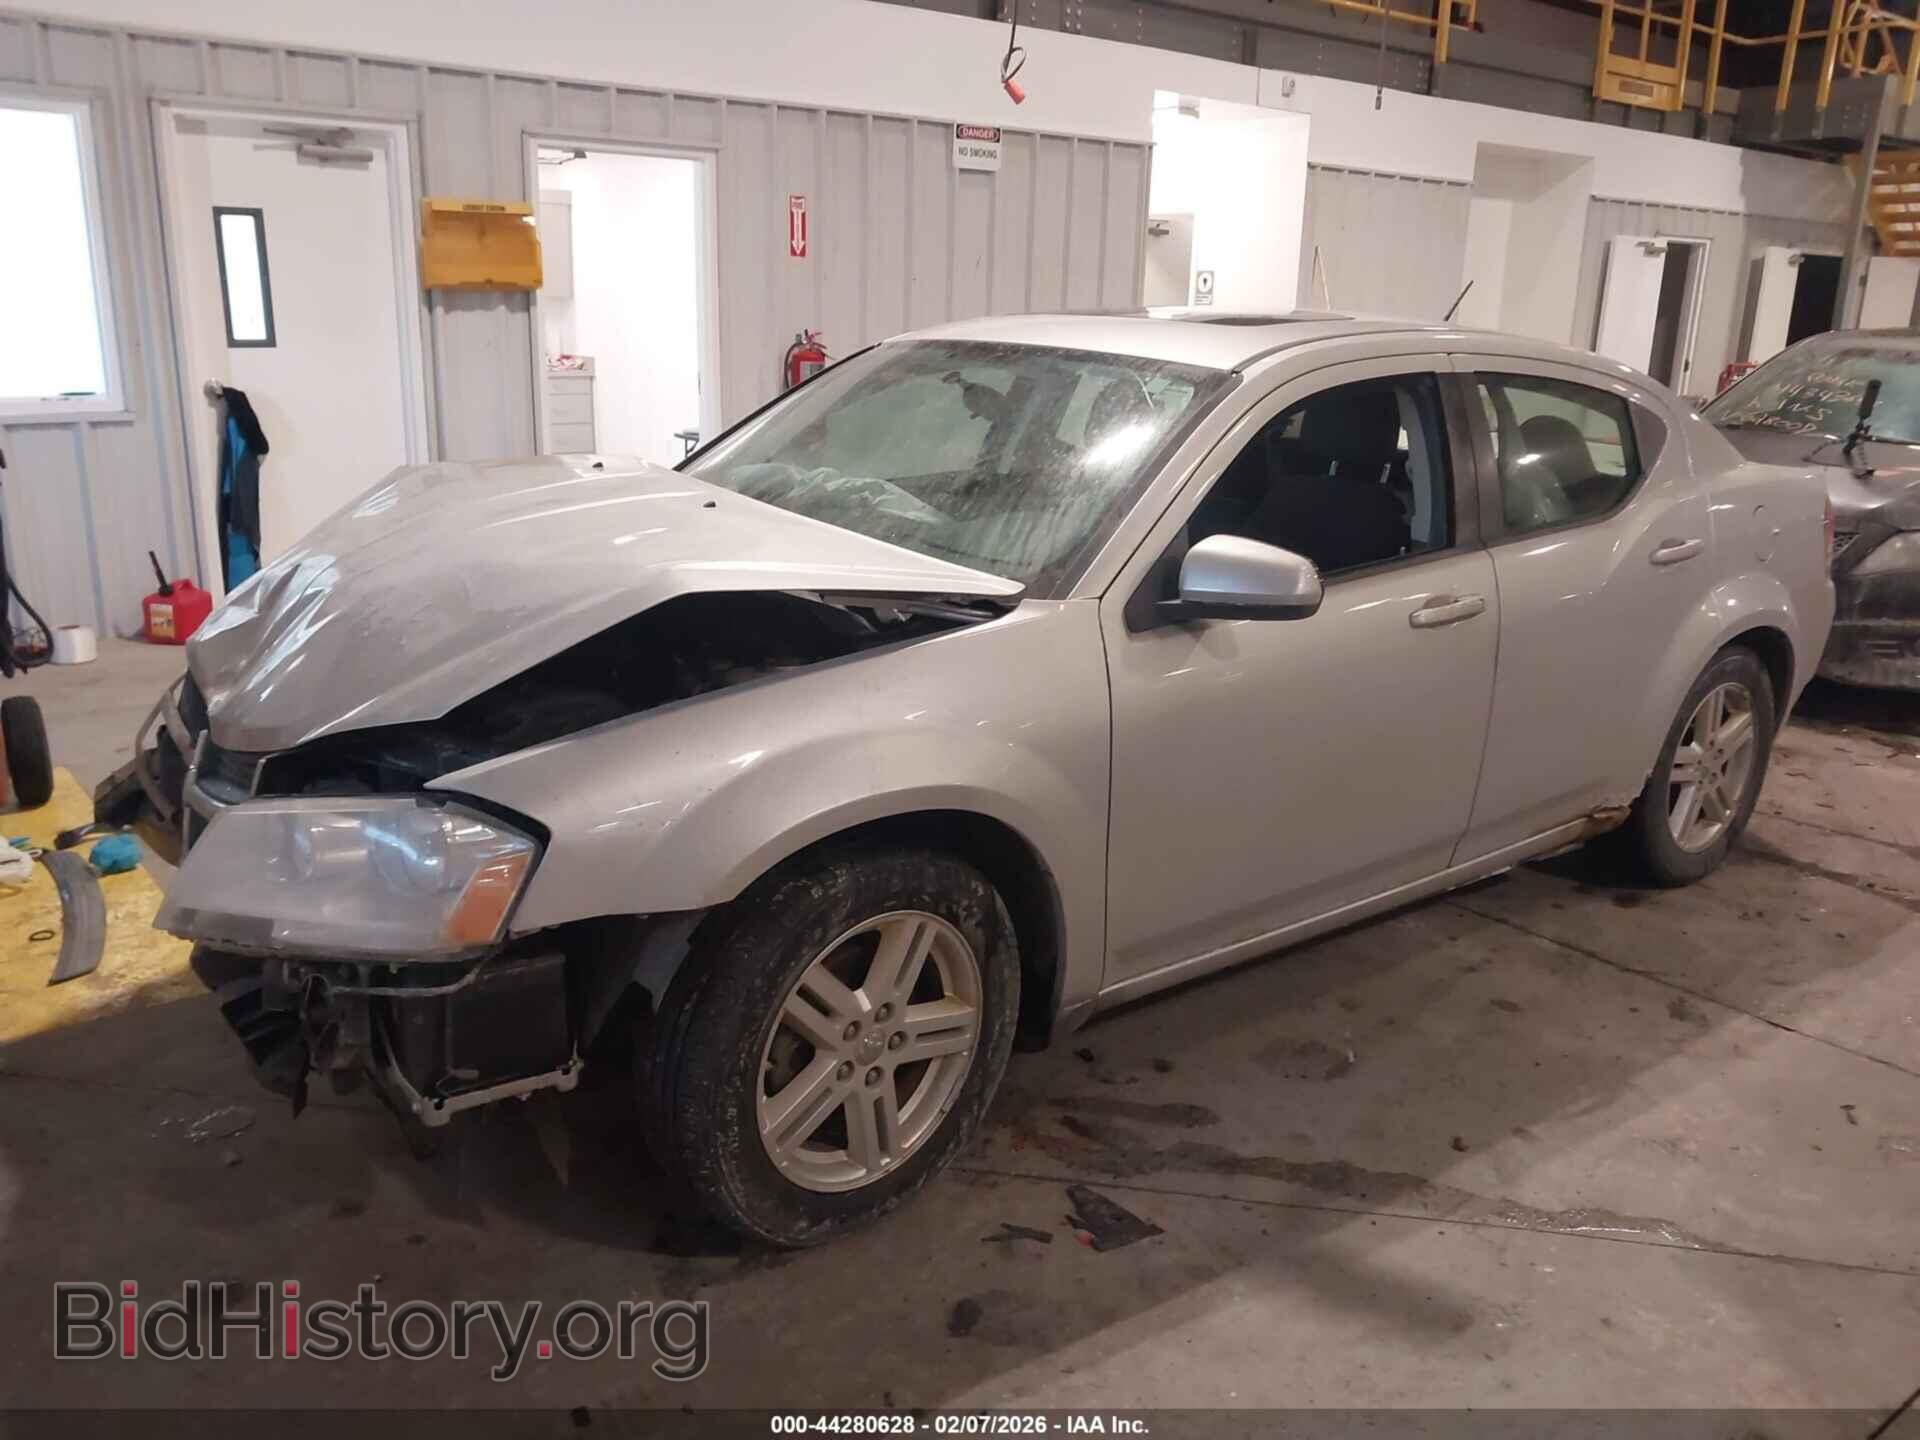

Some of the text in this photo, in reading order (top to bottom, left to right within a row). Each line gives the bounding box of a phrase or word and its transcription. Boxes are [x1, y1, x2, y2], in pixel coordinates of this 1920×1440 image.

[962, 127, 994, 138] DANGER
[958, 146, 997, 159] NO SMOKING
